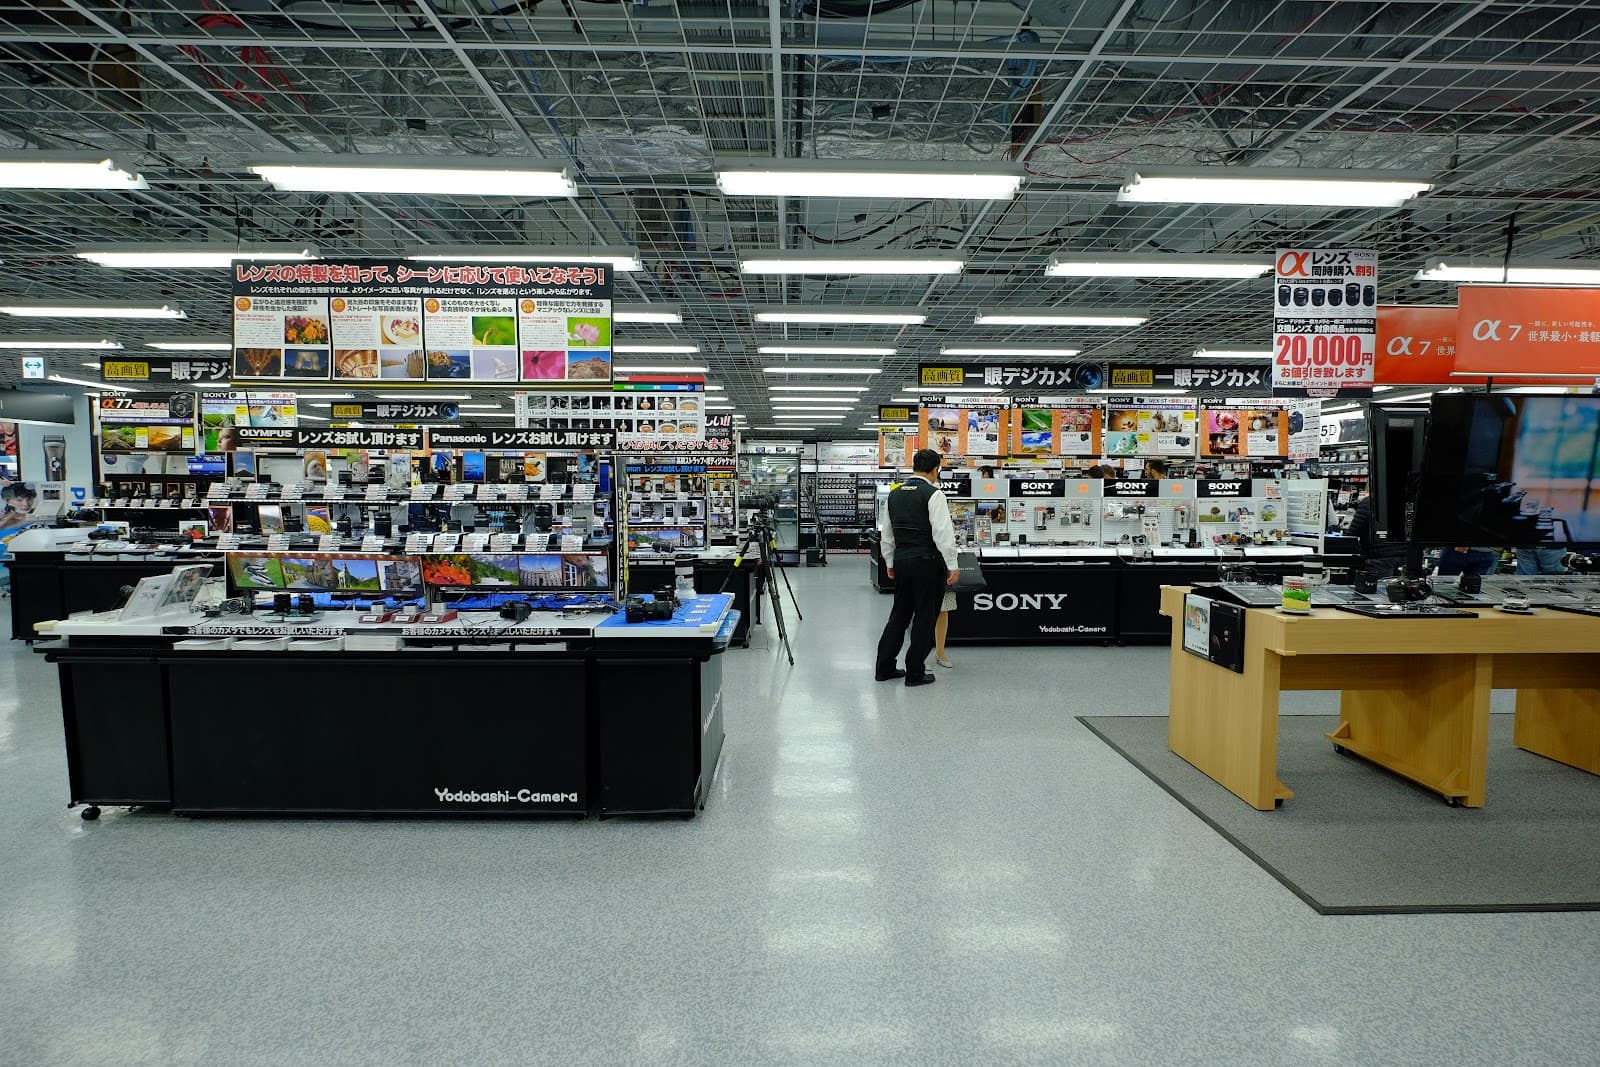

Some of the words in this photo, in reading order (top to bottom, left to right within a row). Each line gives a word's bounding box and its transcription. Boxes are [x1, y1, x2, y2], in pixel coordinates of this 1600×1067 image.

[1277, 251, 1310, 277] α
[1312, 251, 1352, 265] レンズ
[1312, 265, 1375, 277] 同時購入割引
[1276, 335, 1373, 367] 20,000円
[106, 362, 148, 377] 高画質
[151, 361, 231, 380] 一眼デジ
[923, 368, 962, 382] 高画質
[965, 367, 1072, 386] 一眼デジカメ
[1113, 370, 1152, 383] 高画質
[1155, 368, 1261, 387] 一眼デジカメ
[1280, 367, 1365, 378] お値引き致します
[363, 404, 438, 417] 一眼デジカメ
[239, 428, 293, 438] OLYMPUS
[298, 431, 421, 446] レンズお試し頂けます
[432, 432, 487, 444] Panasonic
[492, 432, 613, 446] レンズお試し頂けます
[1021, 482, 1054, 490] SONY
[1115, 482, 1149, 490] SONY
[1208, 482, 1242, 490] SONY
[973, 592, 1068, 611] SONY
[1038, 625, 1107, 633] Yodobashi-Camera
[434, 787, 578, 803] Yodobashi-Camera
